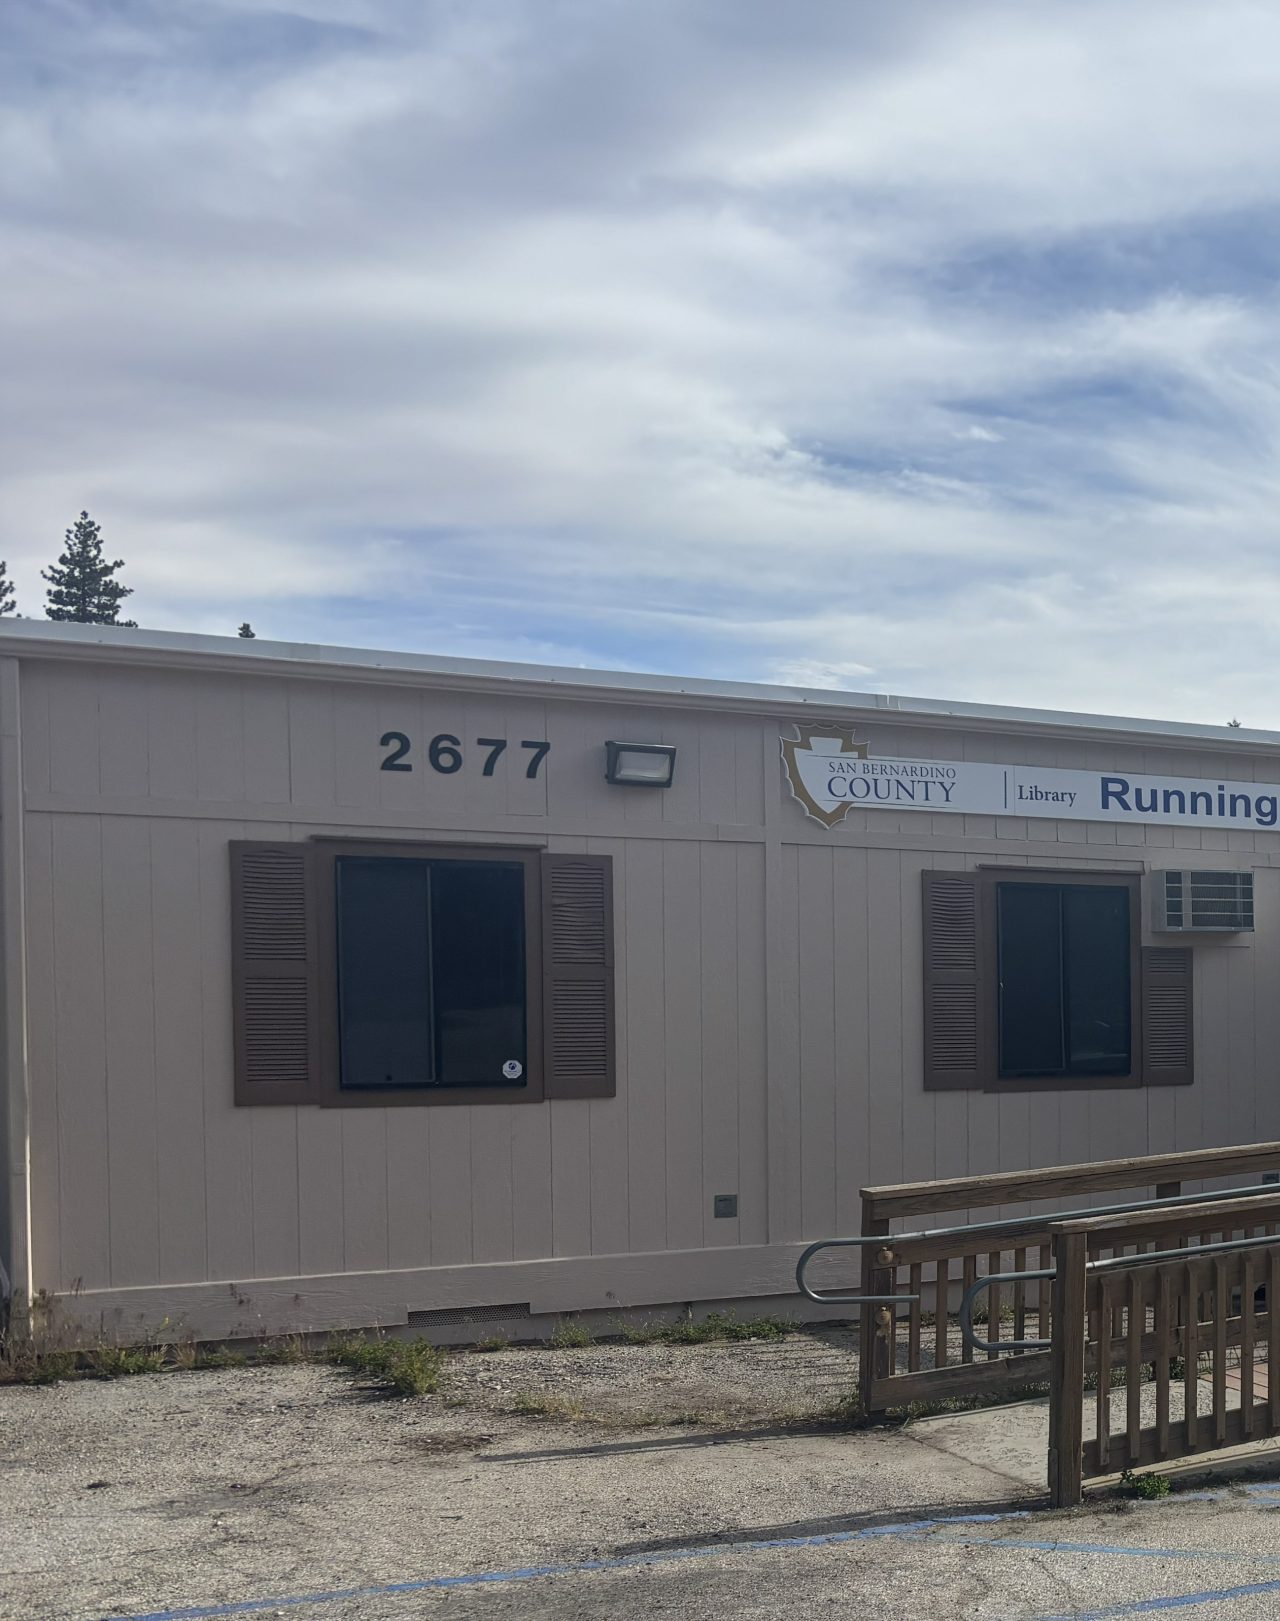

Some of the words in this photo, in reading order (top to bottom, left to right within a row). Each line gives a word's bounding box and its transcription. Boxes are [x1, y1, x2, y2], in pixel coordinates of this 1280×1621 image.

[379, 731, 551, 779] 2677
[828, 762, 857, 774] SAN
[862, 763, 956, 779] BERNARDINO
[827, 776, 956, 802] COUNTY
[1017, 785, 1077, 807] Library
[1100, 777, 1278, 826] Running
